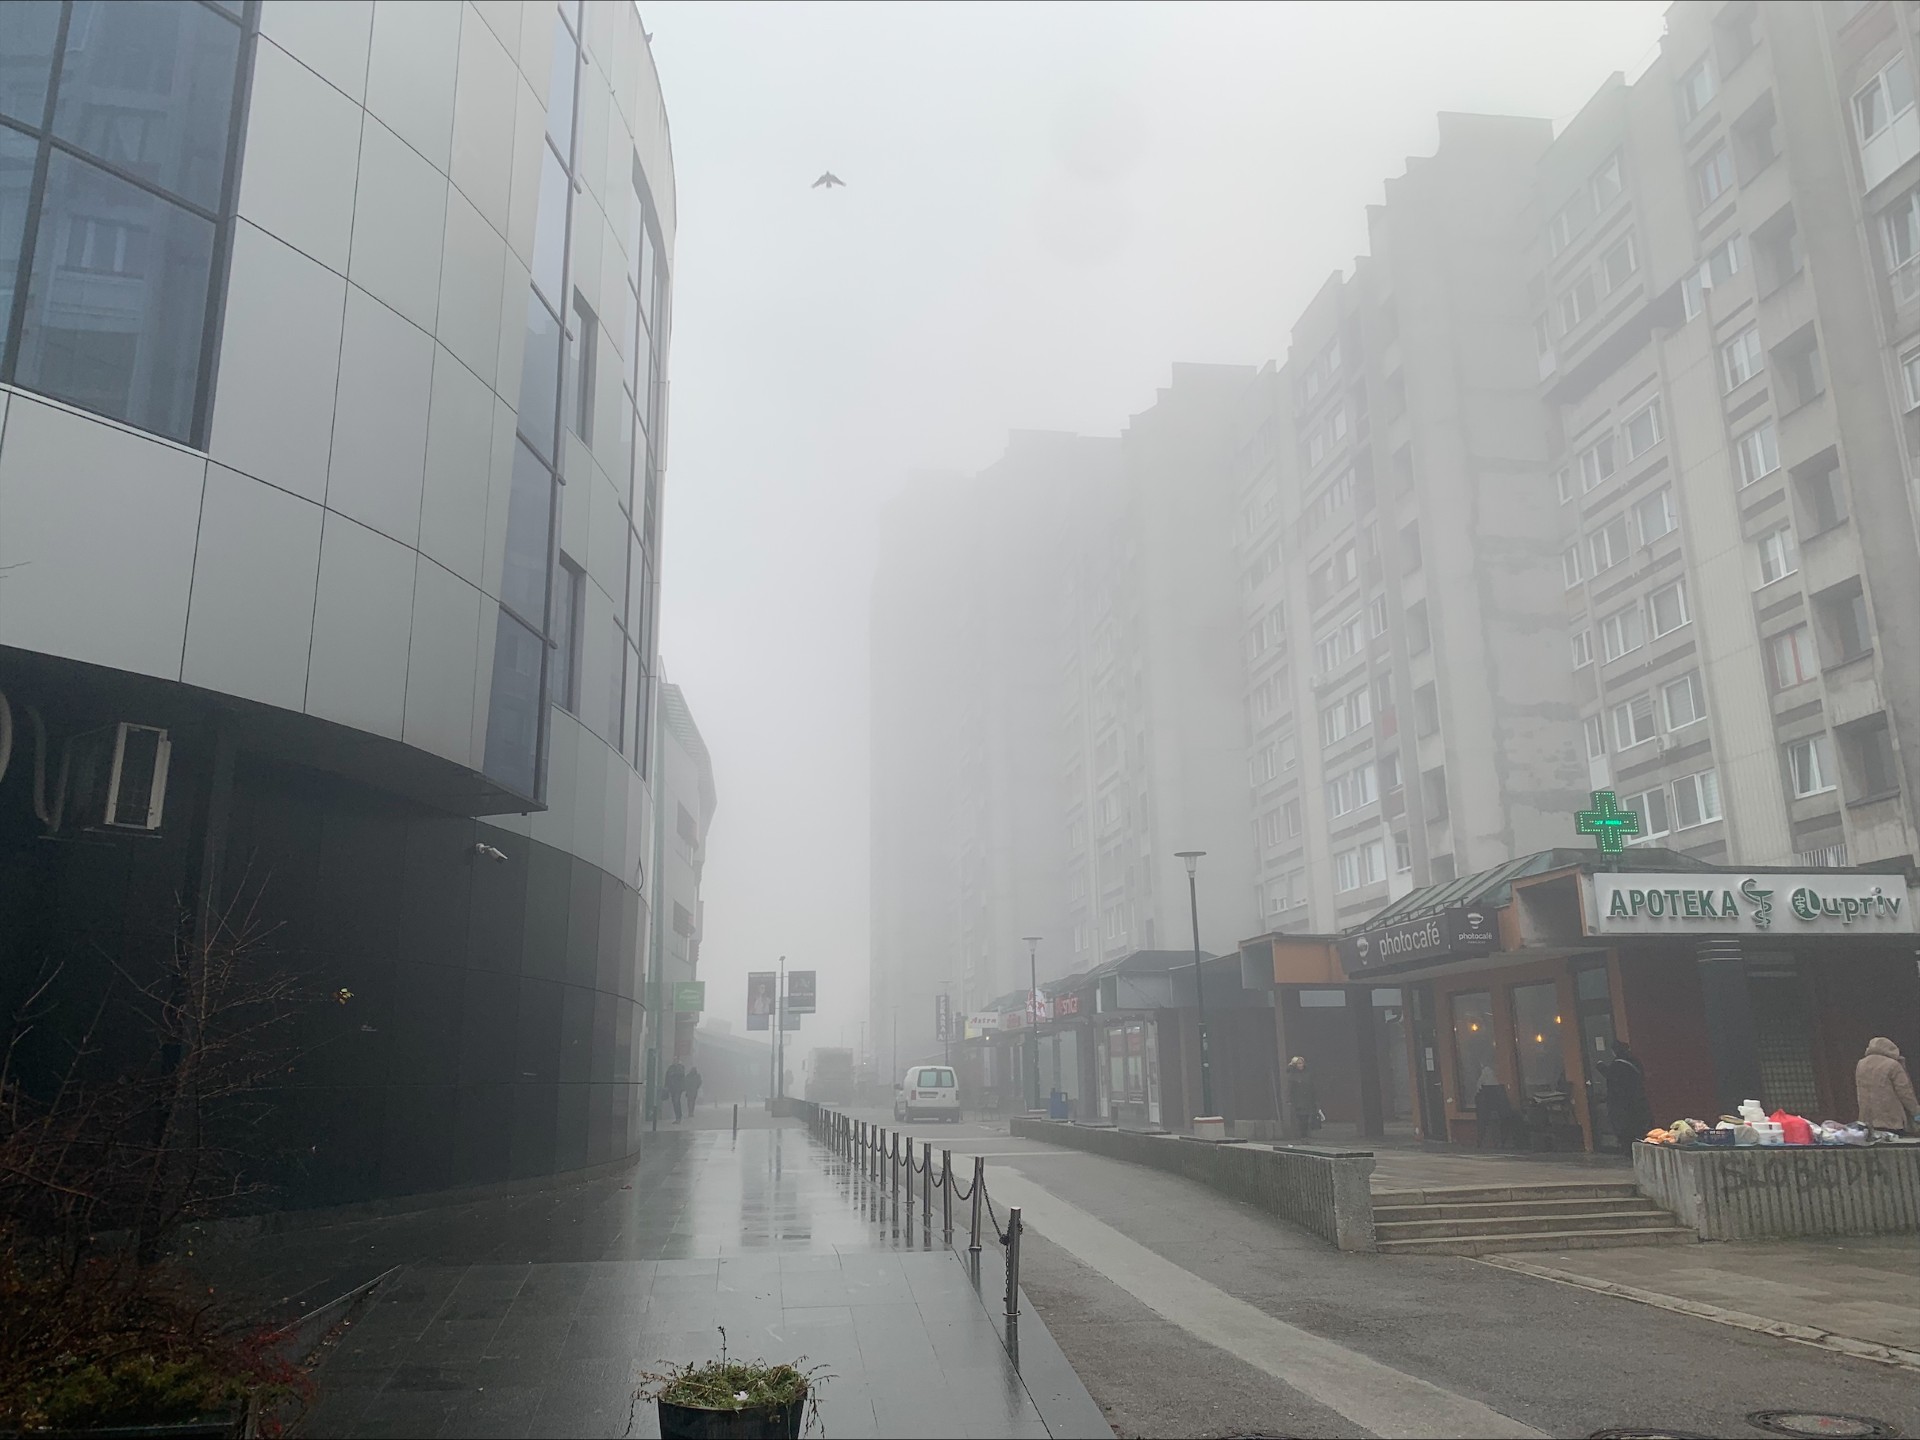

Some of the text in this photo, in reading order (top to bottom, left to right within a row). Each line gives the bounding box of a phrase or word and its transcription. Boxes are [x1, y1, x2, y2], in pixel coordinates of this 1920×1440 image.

[1608, 888, 1740, 919] APOTEKA
[1379, 921, 1440, 962] photocafé
[1458, 932, 1492, 941] photocafé
[1719, 1155, 1892, 1193] SLOBODA
